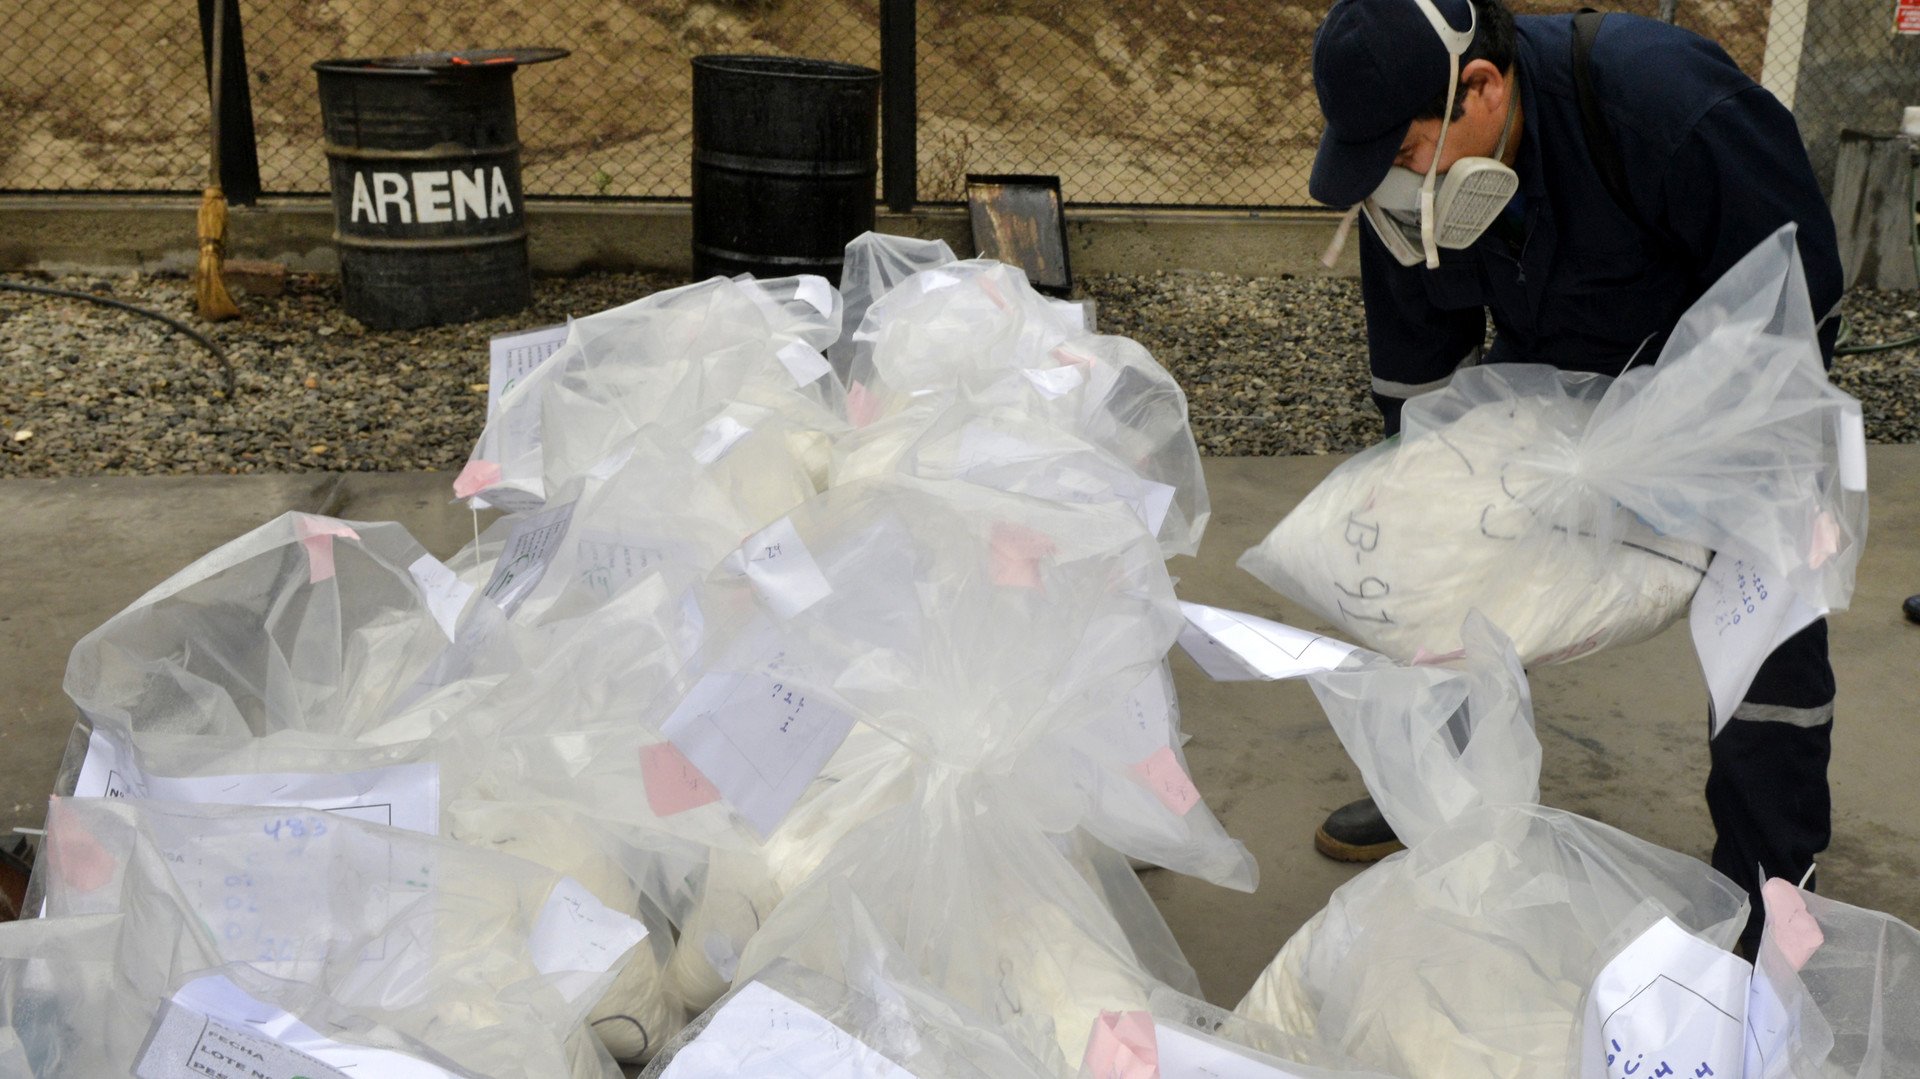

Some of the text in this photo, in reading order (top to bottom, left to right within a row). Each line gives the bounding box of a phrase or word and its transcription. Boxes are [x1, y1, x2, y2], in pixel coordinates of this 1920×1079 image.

[351, 166, 514, 223] ARENA
[201, 1045, 246, 1072] LOTE
[208, 1030, 264, 1061] FECHA
